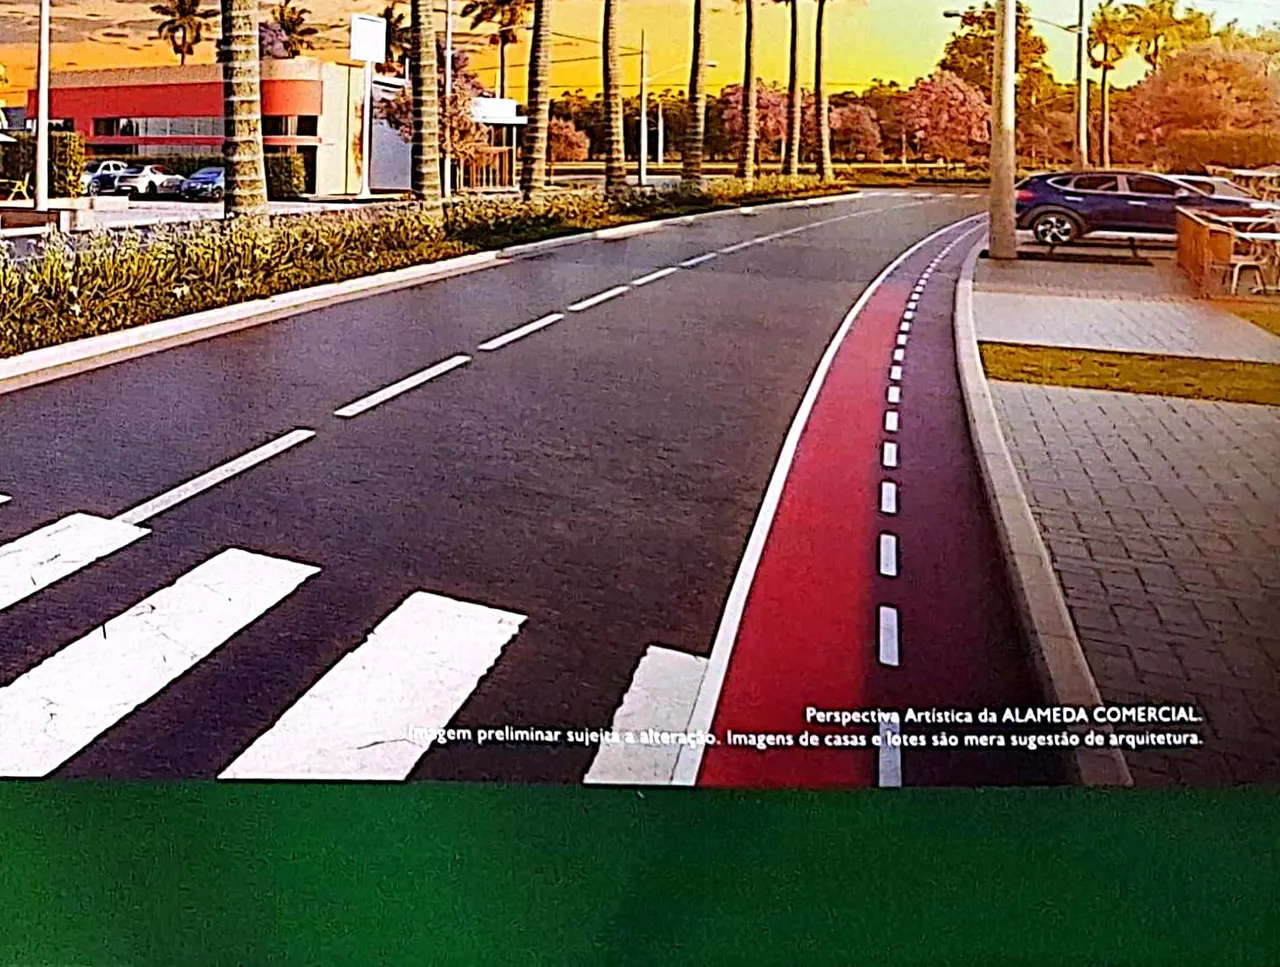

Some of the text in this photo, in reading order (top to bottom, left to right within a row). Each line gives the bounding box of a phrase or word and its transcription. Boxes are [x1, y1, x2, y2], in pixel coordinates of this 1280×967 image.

[805, 706, 1204, 727] Perspectiva Artística da ALAMEDA COMERCIAL.
[477, 725, 561, 745] preliminar
[624, 732, 636, 745] a
[640, 728, 721, 749] alteração.
[726, 730, 795, 750] Imagens
[799, 730, 820, 746] de
[824, 734, 867, 747] casas
[871, 734, 882, 747] e
[886, 730, 927, 747] lotes
[931, 731, 959, 747] são
[964, 734, 1006, 747] mera
[1010, 731, 1080, 750] sugestão
[1084, 730, 1105, 746] de
[1109, 731, 1204, 749] arquitetura.
